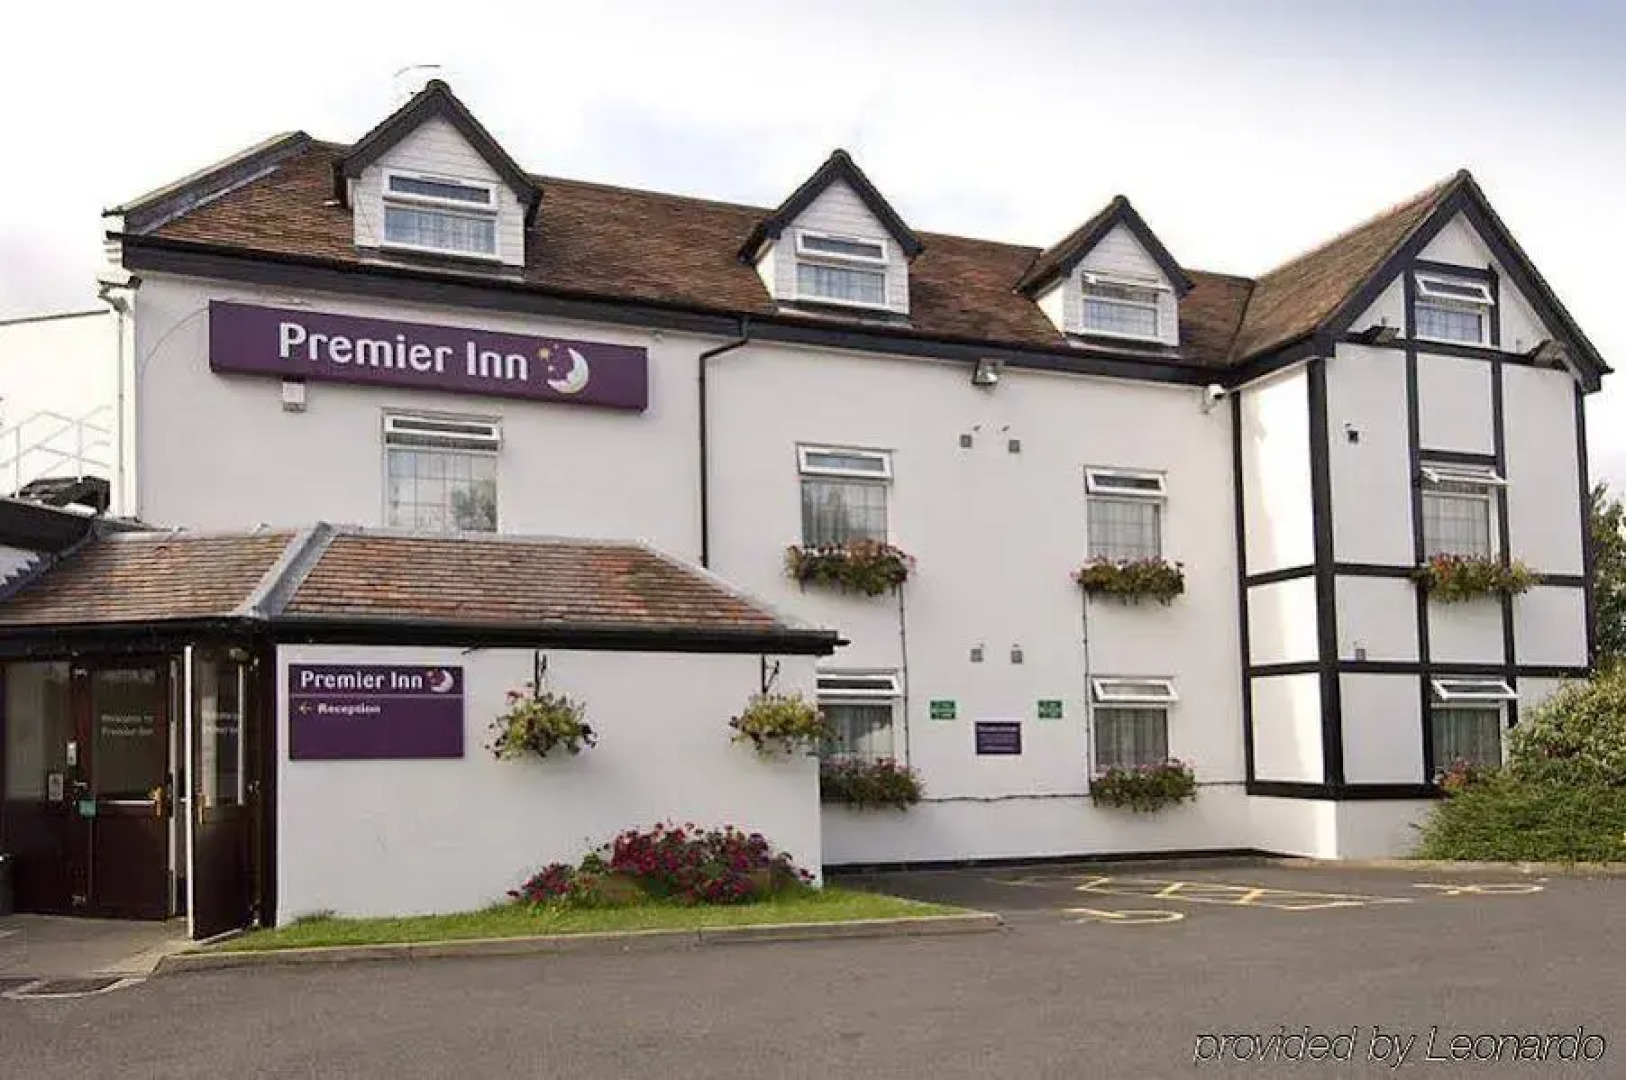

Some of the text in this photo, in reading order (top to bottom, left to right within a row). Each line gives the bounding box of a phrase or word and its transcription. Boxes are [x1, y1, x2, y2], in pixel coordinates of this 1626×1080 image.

[278, 322, 528, 381] Premier Inn
[301, 670, 423, 690] Premier Inn
[318, 702, 382, 716] Reception
